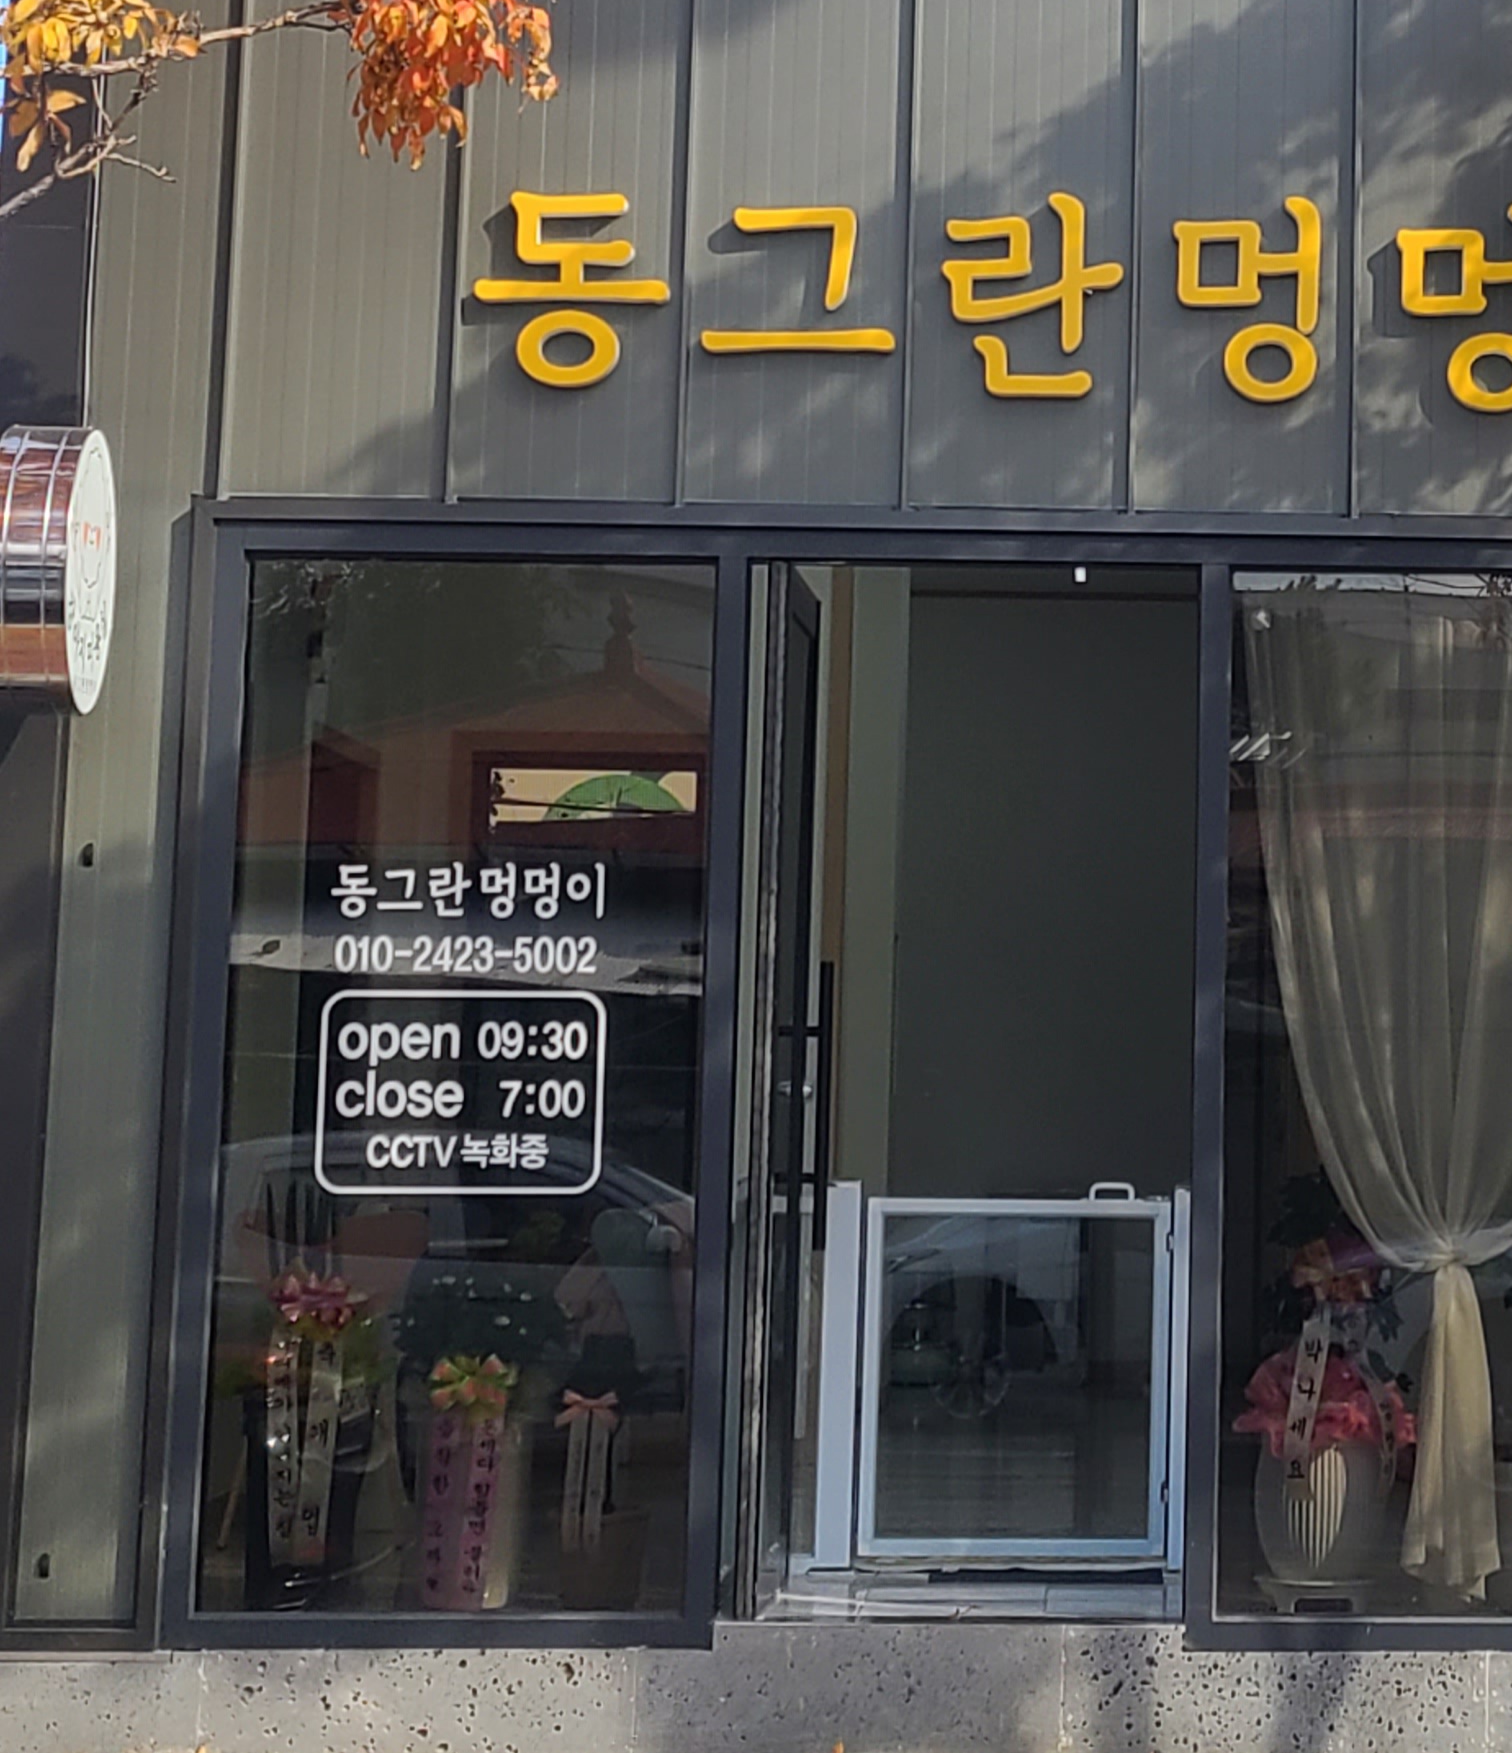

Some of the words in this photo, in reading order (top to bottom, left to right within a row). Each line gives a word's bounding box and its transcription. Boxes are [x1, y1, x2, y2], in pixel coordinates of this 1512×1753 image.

[334, 935, 597, 974] 010-2423-5002
[337, 1021, 461, 1066] open
[477, 1020, 588, 1061] 09:30
[335, 1068, 464, 1118] close
[499, 1079, 586, 1119] 7:00
[366, 1134, 458, 1169] CCTV
[460, 1132, 549, 1169] 녹화중
